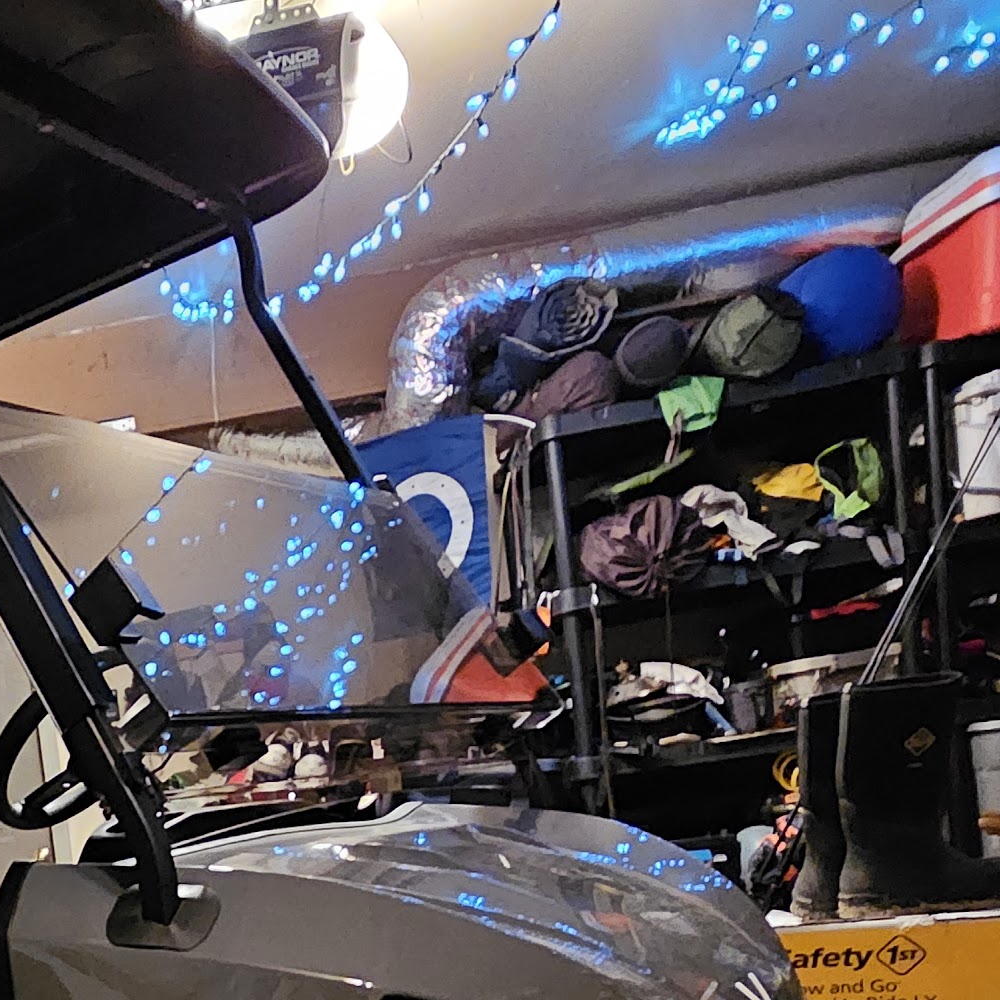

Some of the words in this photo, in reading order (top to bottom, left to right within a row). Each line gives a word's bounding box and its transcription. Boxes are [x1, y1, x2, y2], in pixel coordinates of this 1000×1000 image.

[256, 48, 320, 73] AYNOR
[787, 947, 874, 971] afety
[830, 978, 864, 995] and
[870, 978, 898, 993] Go
